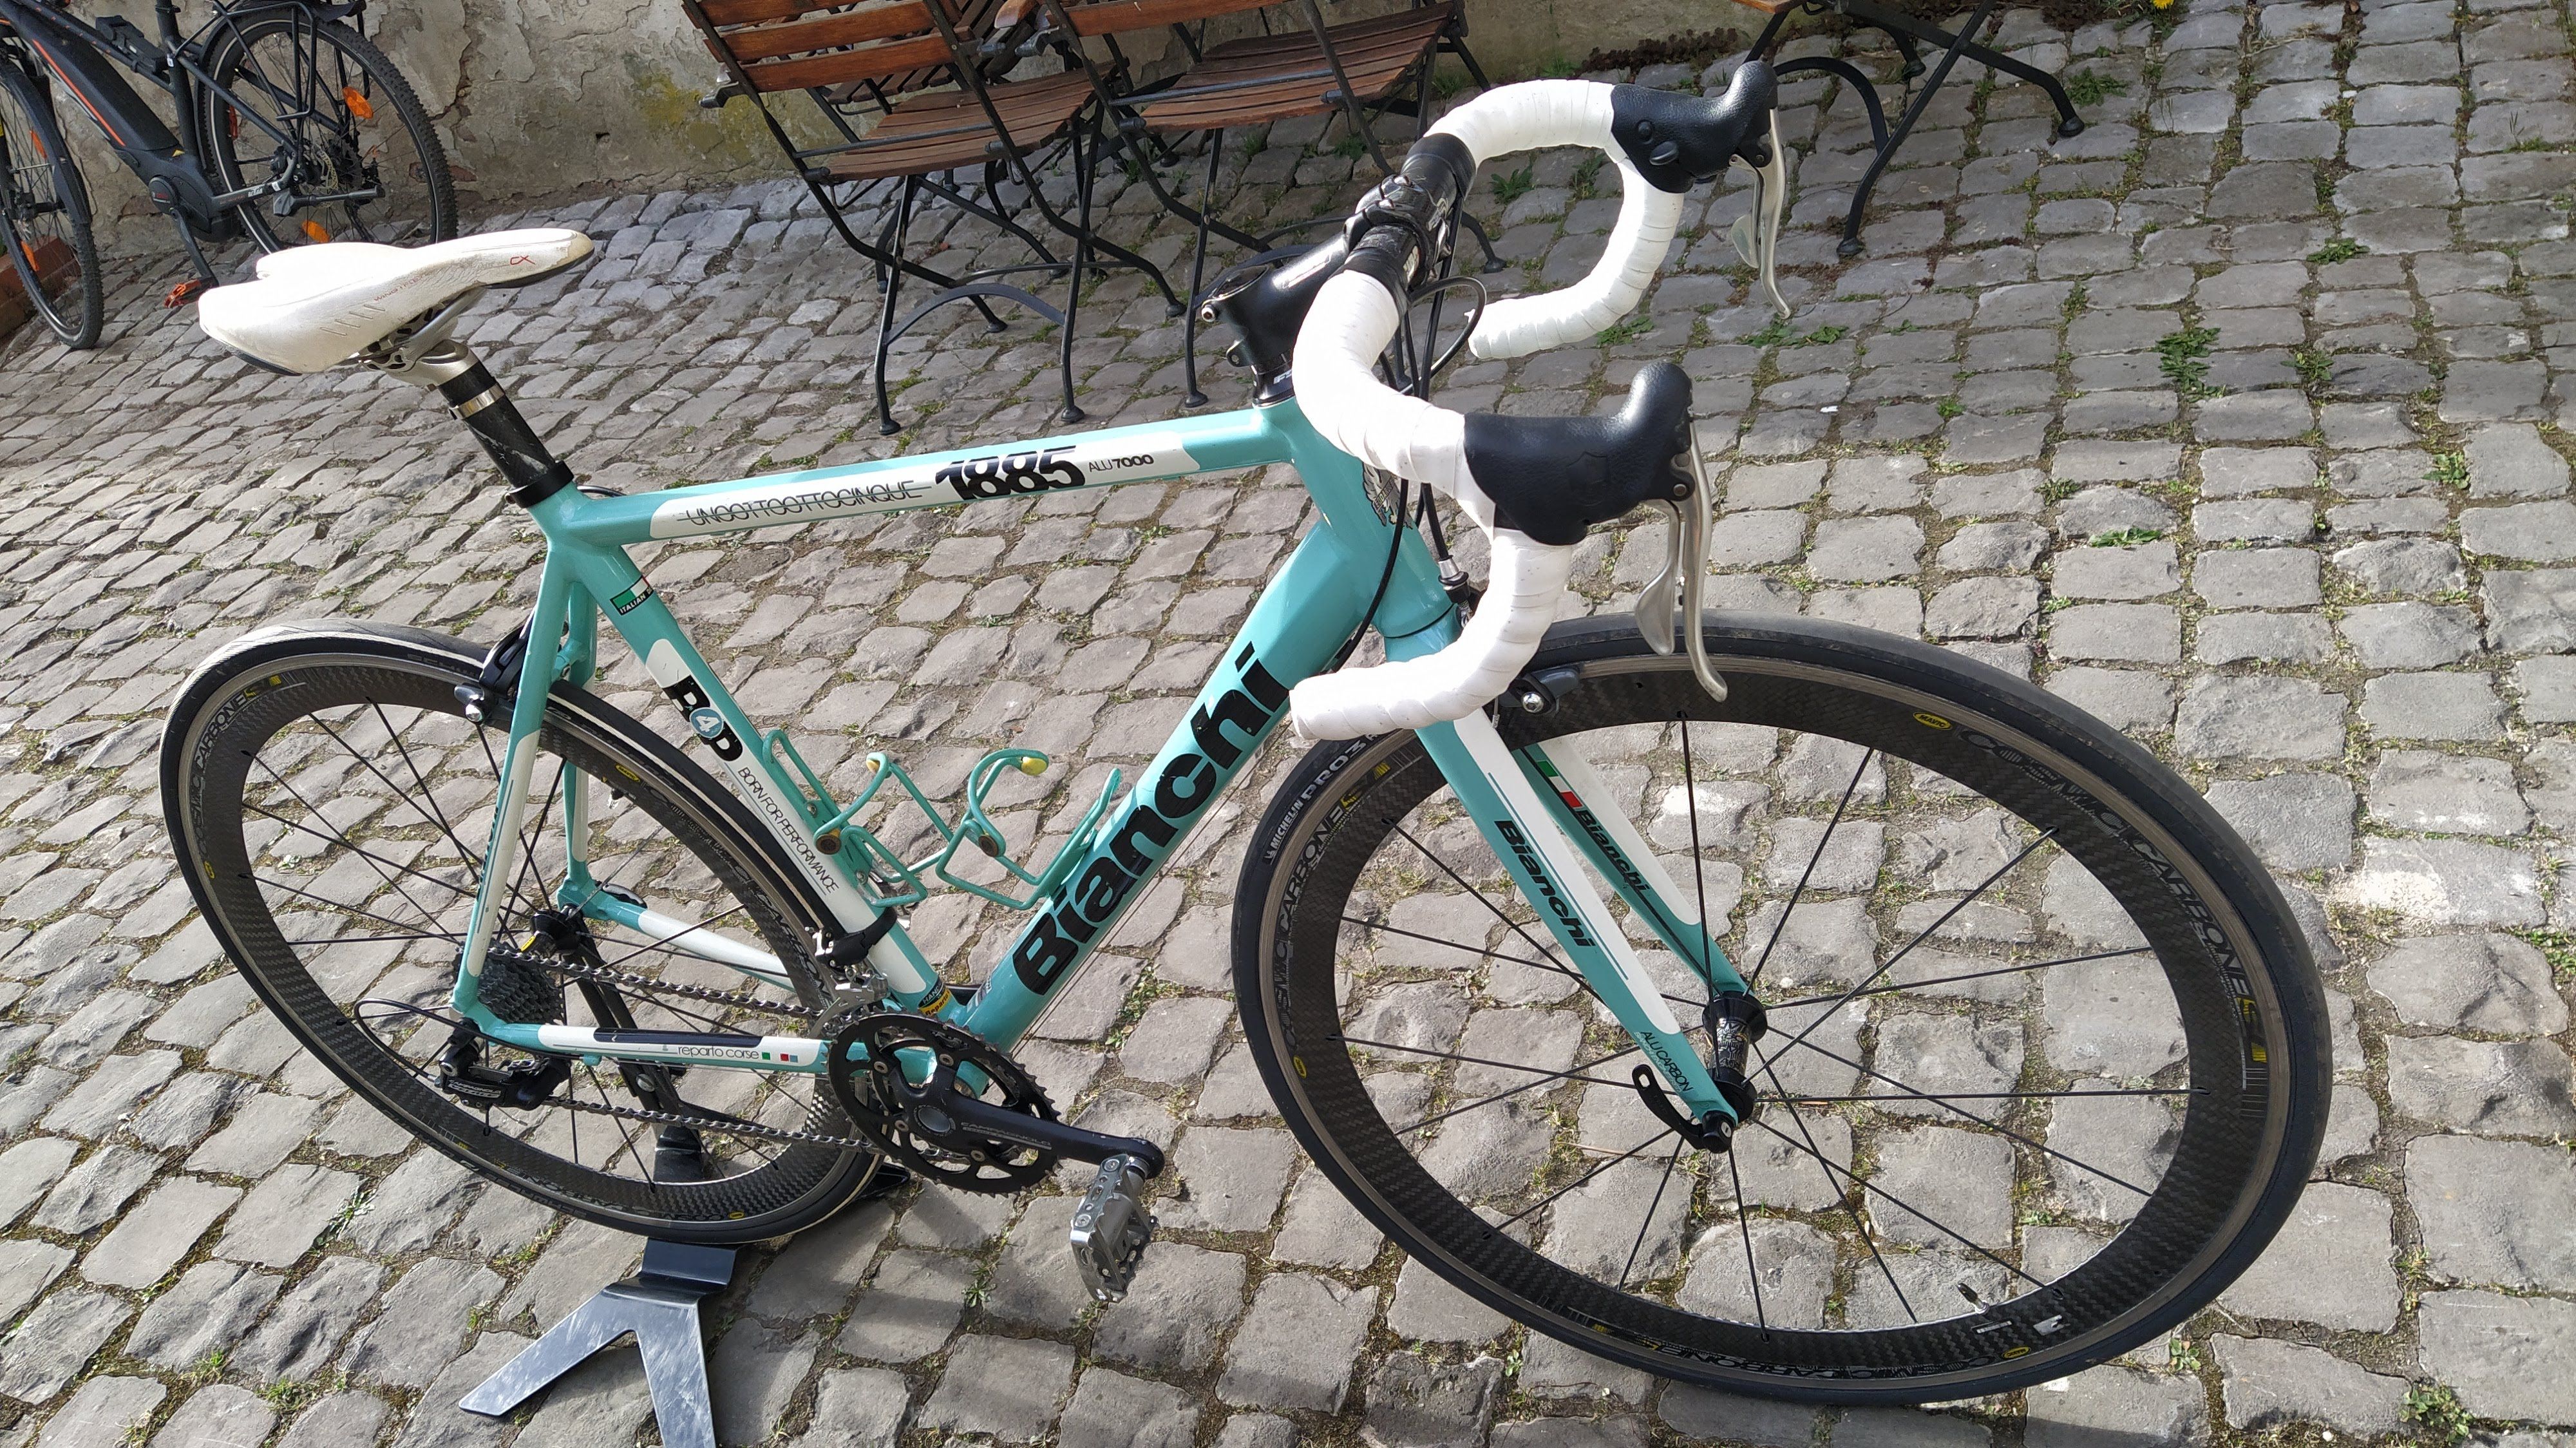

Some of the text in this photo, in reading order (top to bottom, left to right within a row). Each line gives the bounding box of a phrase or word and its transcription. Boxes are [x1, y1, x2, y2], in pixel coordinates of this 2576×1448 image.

[935, 445, 1086, 500] 1885
[619, 593, 647, 614] ITALIAN
[738, 767, 840, 894] BORN FOR PERFORMANCE
[1012, 641, 1290, 996] Bianchi
[1270, 799, 1304, 850] MICHELIN
[1577, 808, 1651, 891] Bianchi
[1494, 820, 1596, 947] Bianchi
[678, 1045, 759, 1060] reparto corse
